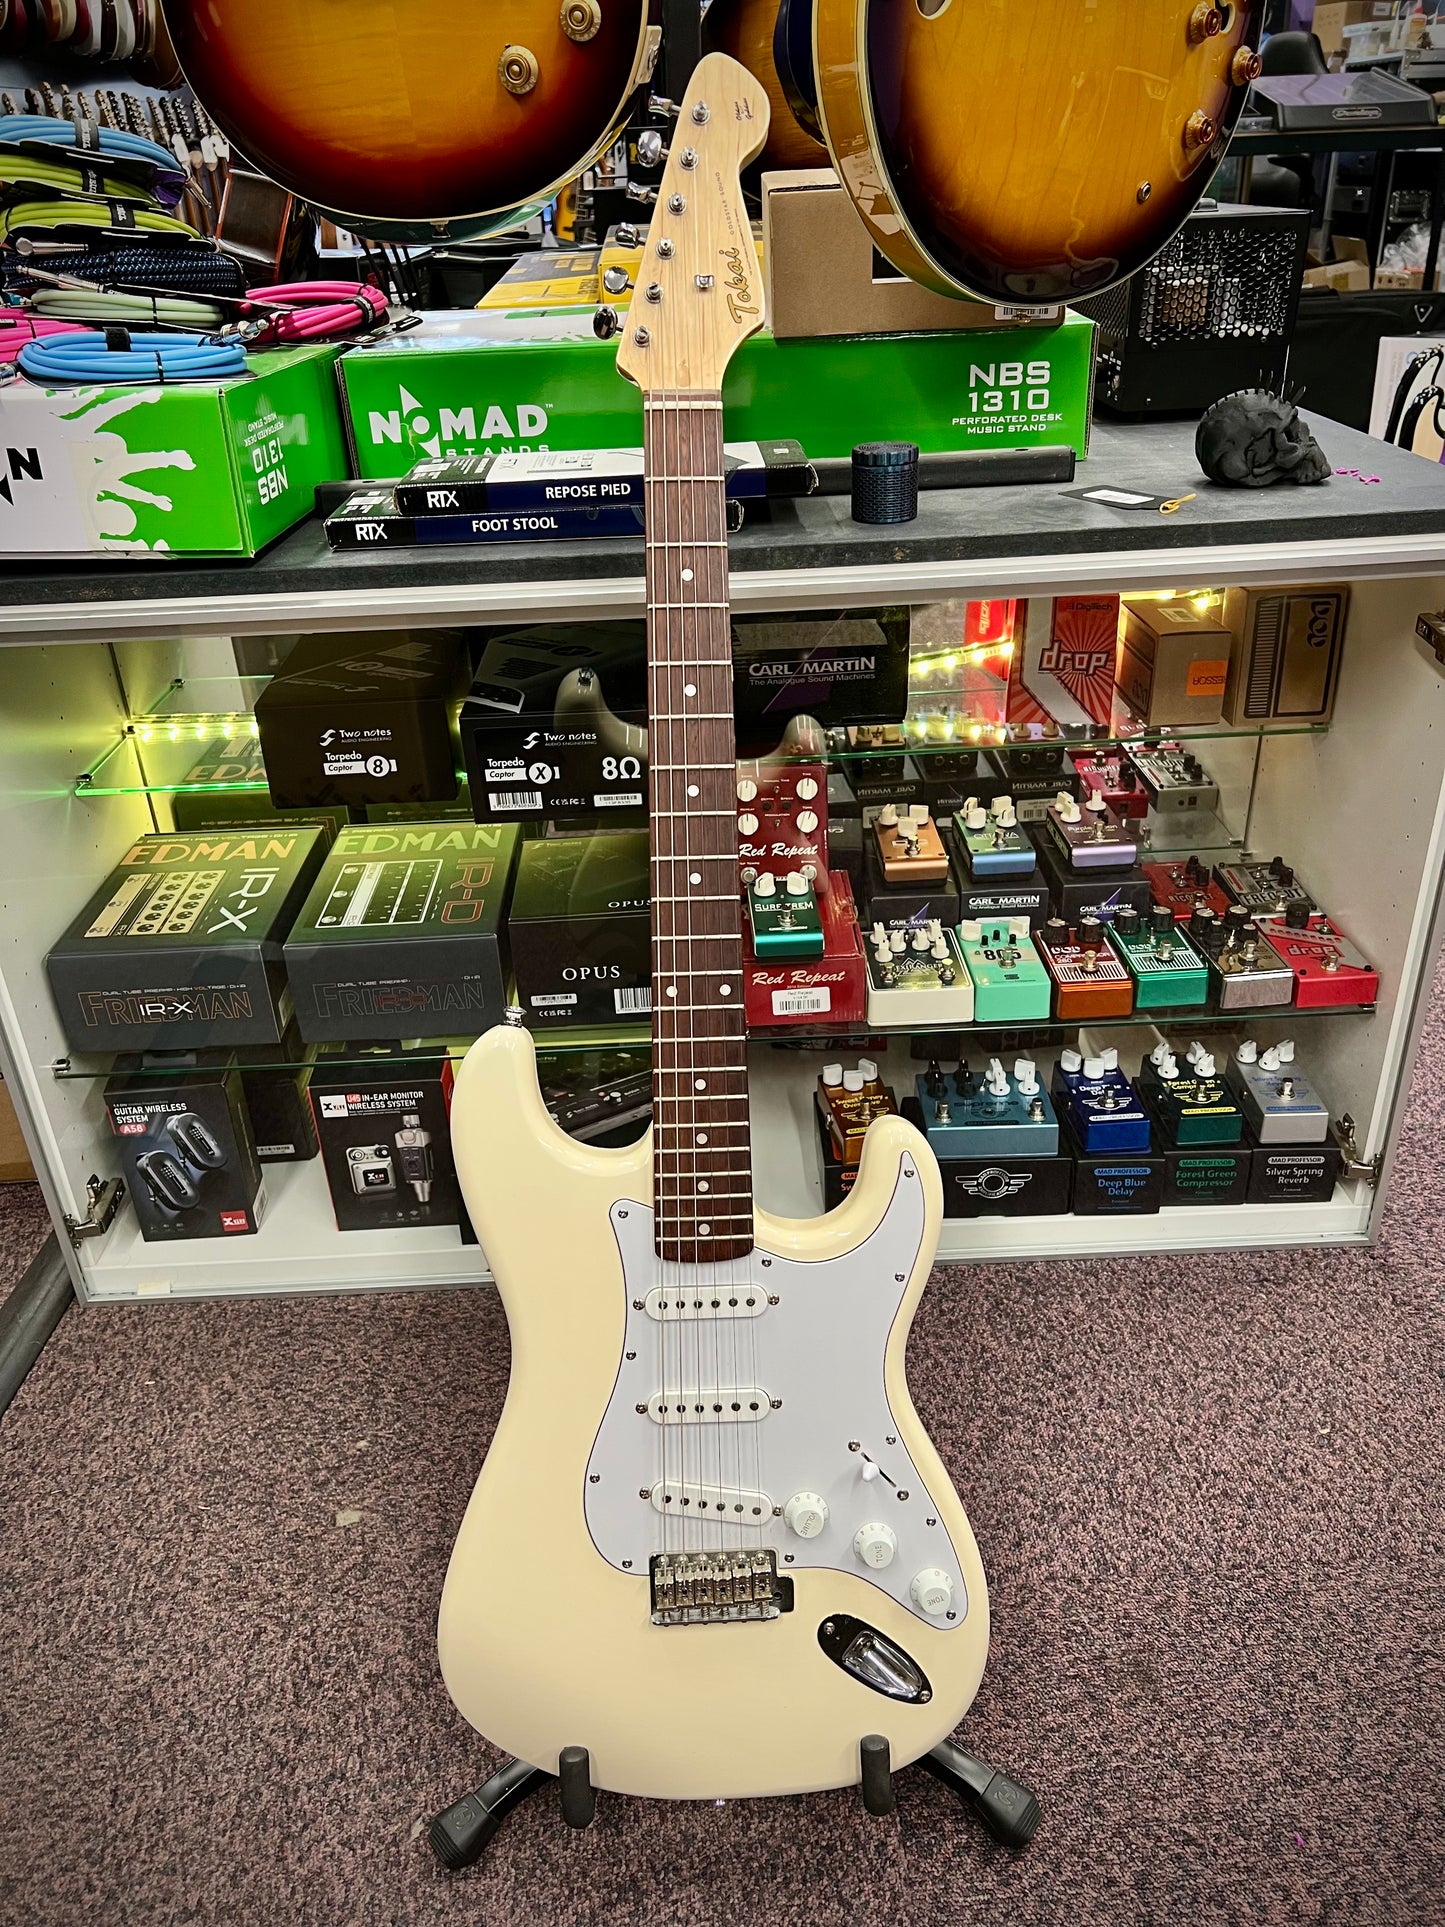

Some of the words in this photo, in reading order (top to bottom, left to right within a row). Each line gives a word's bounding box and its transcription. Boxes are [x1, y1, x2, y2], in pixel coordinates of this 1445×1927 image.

[719, 247, 760, 324] Tokai
[970, 361, 1050, 387] NBS
[969, 389, 1050, 413] 1310
[368, 403, 549, 446] NOMAD
[952, 415, 1027, 425] PERFORATED
[1031, 413, 1063, 422] DESK
[967, 425, 1004, 434] MUSIC
[1008, 424, 1046, 432] STAND
[252, 437, 284, 474] 1310
[257, 464, 288, 505] NBS
[426, 490, 459, 508] RTX
[545, 486, 597, 499] REPOSE
[600, 483, 631, 496] PIED
[355, 522, 387, 541] RTX
[472, 519, 509, 533] FOOT
[513, 516, 558, 531] STOOL
[1040, 640, 1109, 676] drop
[749, 663, 793, 676] CARL
[802, 656, 875, 674] MARTIN
[767, 677, 805, 686] Analogue
[808, 675, 834, 683] Sound
[836, 673, 875, 681] Machines
[339, 729, 361, 738] Two
[363, 728, 392, 737] notes
[544, 732, 566, 741] Two
[568, 731, 597, 740] notes
[325, 750, 362, 763] Torpedo
[487, 757, 525, 769] Torpedo
[328, 764, 353, 773] Captor
[373, 758, 383, 774] 8
[489, 771, 515, 779] Captor
[534, 766, 546, 780] X
[602, 756, 641, 780] 8Ω
[739, 843, 767, 857] Red
[771, 842, 819, 859] Repeat
[441, 857, 495, 924] IR-D
[206, 867, 280, 935] IR-X
[607, 899, 651, 908] OPUS
[969, 897, 994, 905] CARL
[999, 895, 1040, 904] MARTIN
[1101, 903, 1133, 911] MARTIN
[755, 903, 781, 912] SURF
[562, 965, 620, 981] OPUS
[752, 971, 785, 985] Red
[791, 970, 846, 985] Repeat
[312, 983, 485, 1018] FRIEDMAN
[77, 991, 253, 1027] FRIEDMAN
[140, 1001, 194, 1016] IR-X
[362, 1093, 388, 1101] IN-EAR
[390, 1091, 424, 1100] MONITOR
[114, 1106, 144, 1116] GUITAR
[145, 1103, 187, 1113] WIRELESS
[348, 1101, 385, 1110] WIRELESS
[387, 1100, 416, 1108] SYSTEM
[116, 1114, 149, 1124] SYSTEM
[123, 1125, 143, 1134] A58
[1176, 1170, 1205, 1178] Forest
[1207, 1169, 1237, 1177] Green
[1266, 1167, 1291, 1175] Silver
[1293, 1167, 1323, 1177] Spring
[1098, 1179, 1122, 1189] Deep
[1125, 1179, 1146, 1187] Blue
[1176, 1179, 1234, 1188] Compressor
[1107, 1188, 1134, 1197] Delay
[800, 1512, 817, 1536] VOLUME
[874, 1545, 883, 1563] TONE
[927, 1596, 944, 1606] TONE
